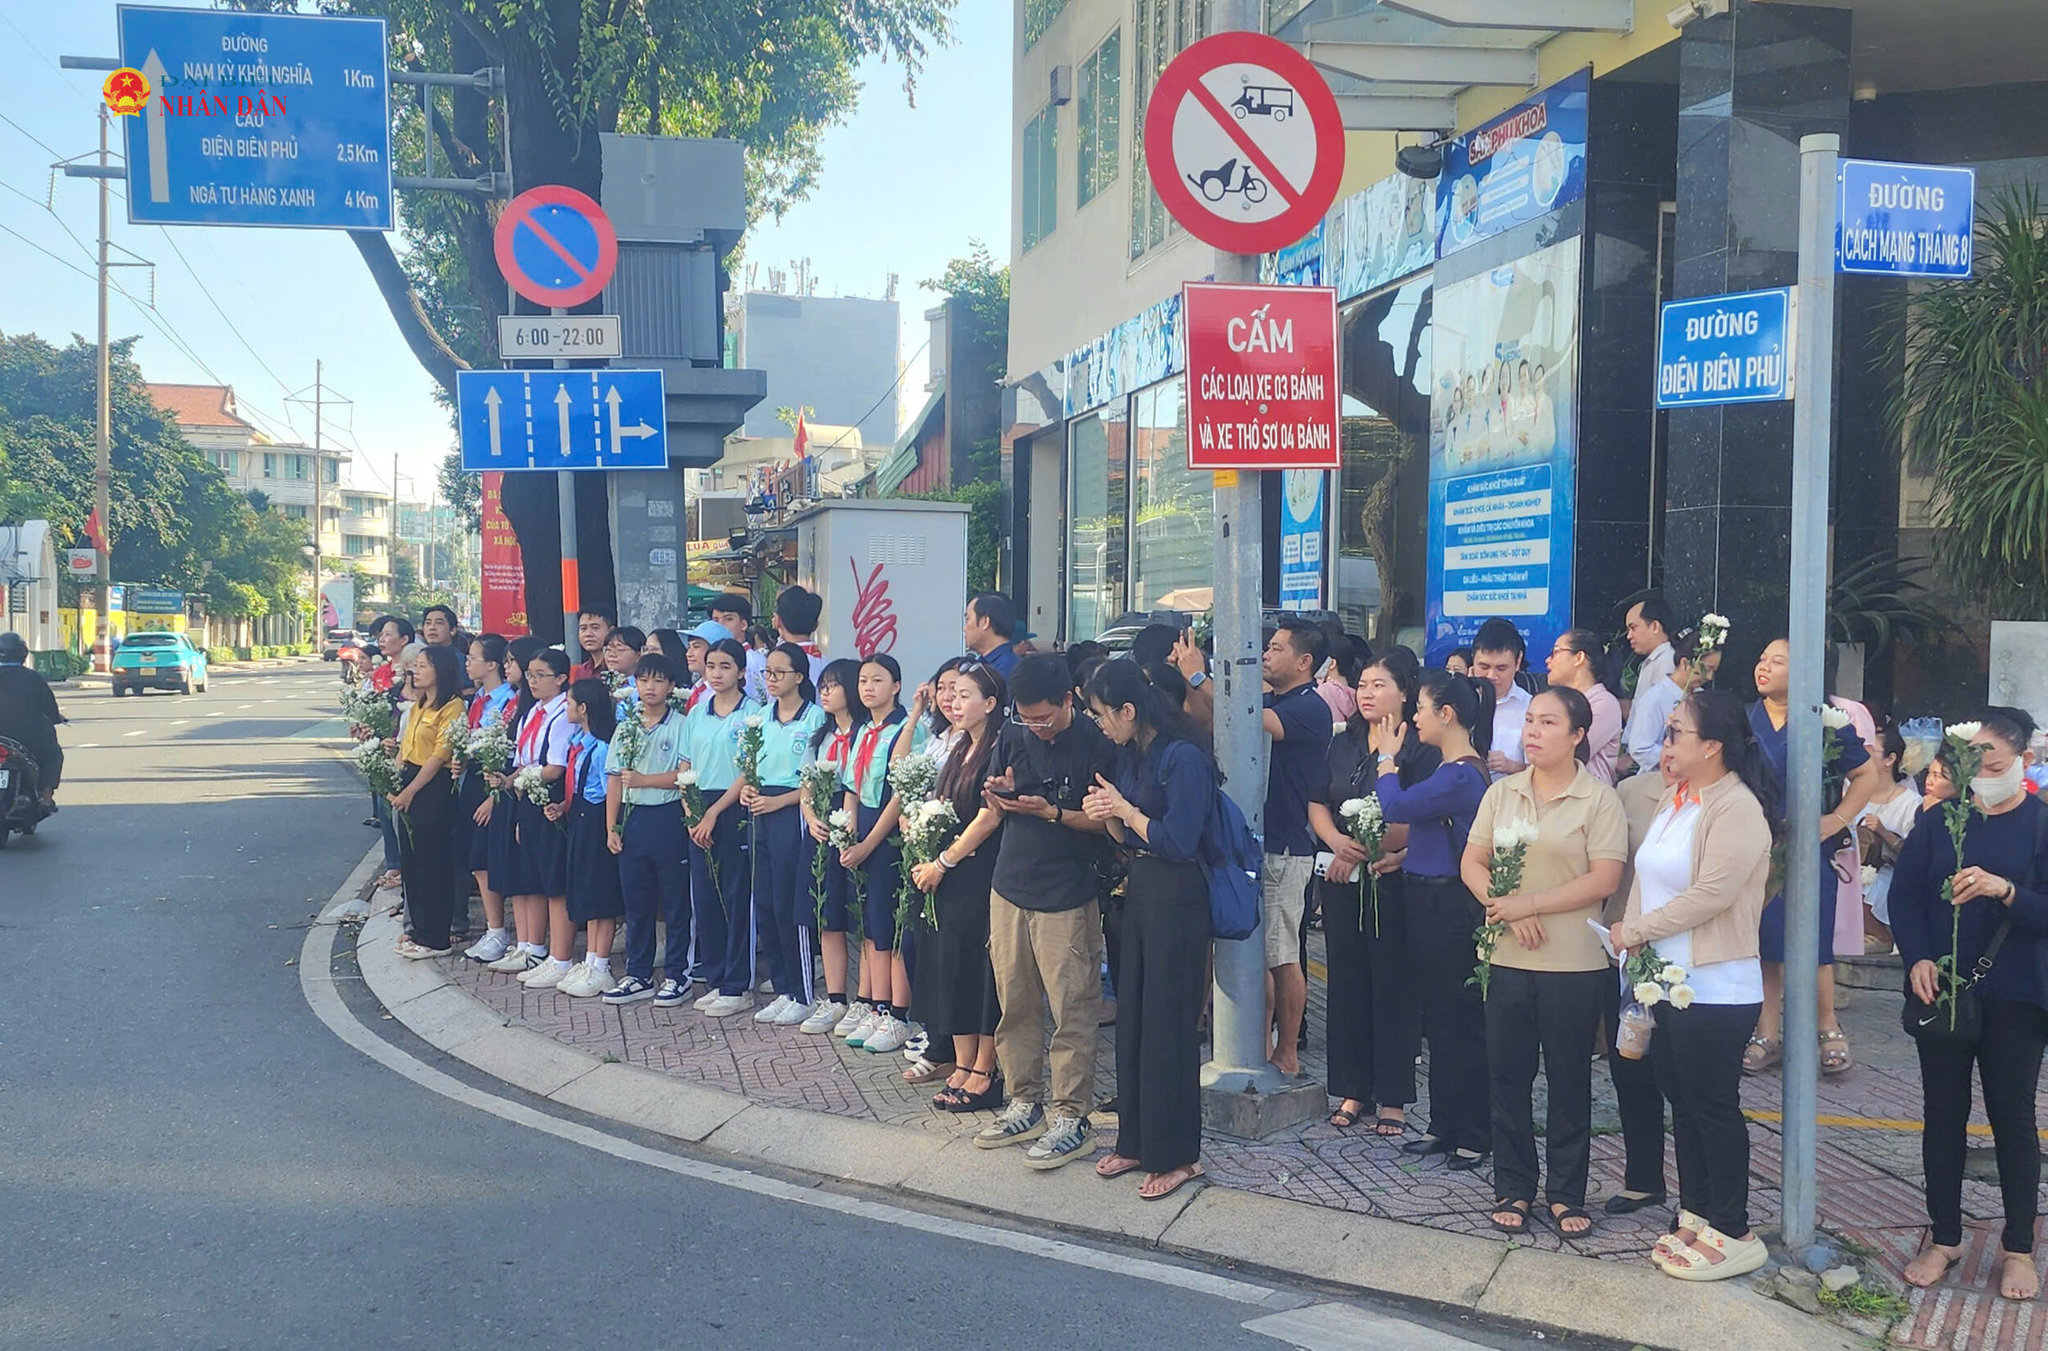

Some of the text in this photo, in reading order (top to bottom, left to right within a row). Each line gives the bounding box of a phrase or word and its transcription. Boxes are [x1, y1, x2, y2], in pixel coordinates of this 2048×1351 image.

[221, 35, 268, 53] ĐƯỜNG
[184, 62, 213, 81] NAM
[218, 59, 234, 81] KỲ
[272, 61, 313, 86] NGHĨA
[1515, 104, 1546, 137] KHOA
[202, 134, 233, 161] ĐIỆN
[237, 135, 268, 158] BIÊN
[271, 134, 298, 160] PHỦ
[190, 182, 379, 209] NGÃ TƯ HÀNG XANH 4 Km
[1868, 175, 1945, 212] ĐƯỜNG
[1844, 218, 1969, 270] CÁCH MẠNG THÁNG 8
[1227, 303, 1294, 354] CẤM
[1685, 308, 1759, 342] ĐƯỜNG
[1201, 366, 1324, 405] CÁC LOẠI XE 03 BÁNH
[1661, 343, 1780, 399] ĐIỆN BIÊN PHỦ
[1199, 416, 1330, 450] VÀ XE THÔ SƠ 04 BÁNH
